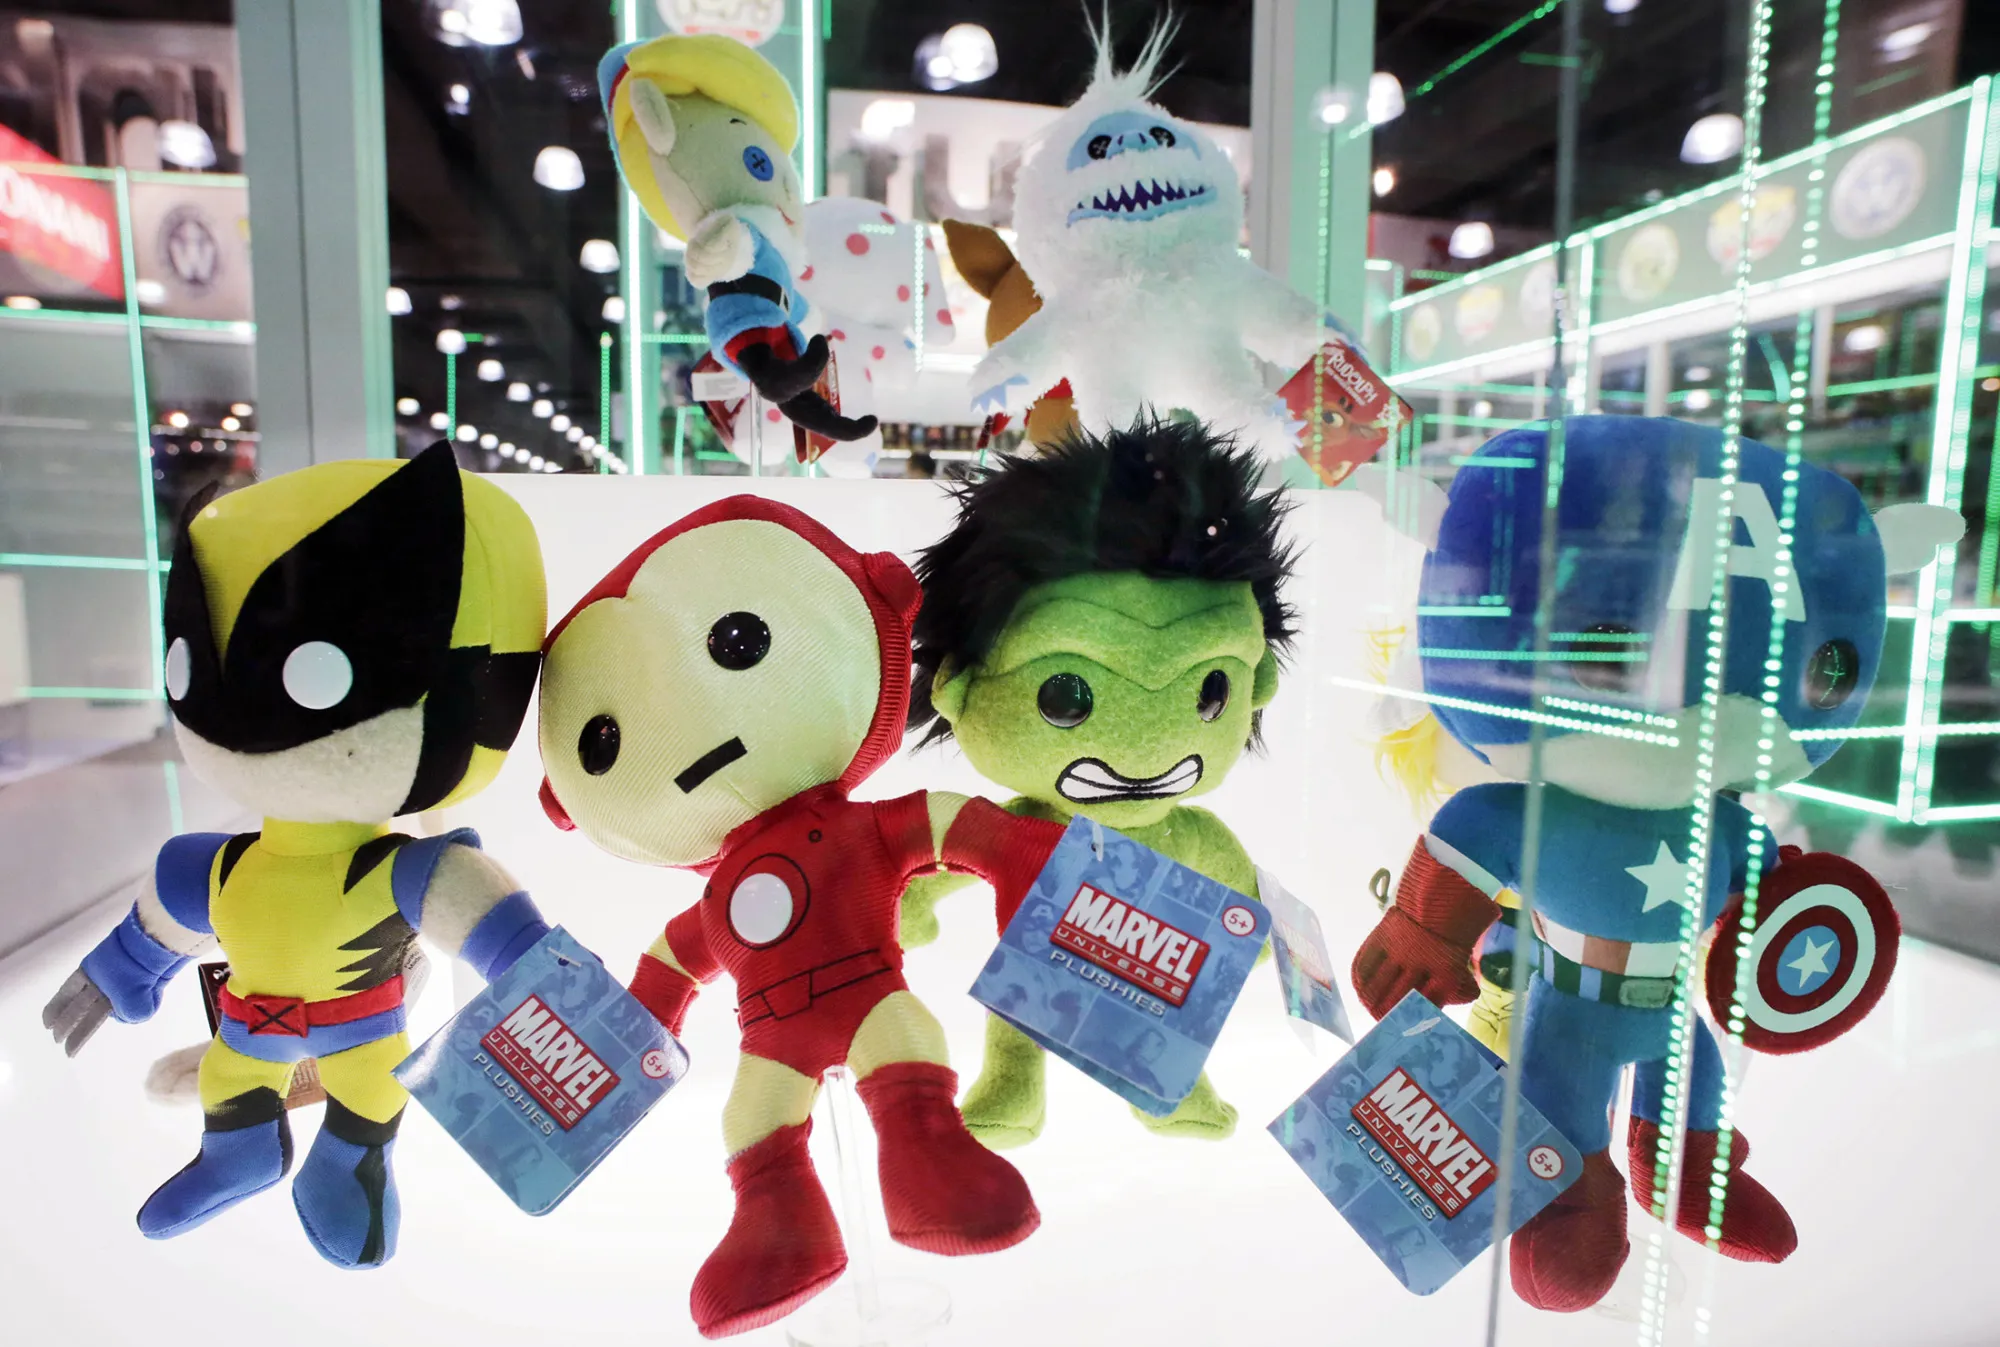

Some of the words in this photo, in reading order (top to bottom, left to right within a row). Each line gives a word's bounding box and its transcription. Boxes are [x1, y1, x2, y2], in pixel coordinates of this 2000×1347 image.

[1327, 352, 1378, 404] RUDOLPH
[1666, 478, 1806, 622] A
[1056, 926, 1185, 998] UNIVERSE
[1064, 885, 1199, 983] MARVEL
[1228, 912, 1249, 930] 5+
[1050, 950, 1167, 1017] PLUSHIES
[473, 1052, 555, 1135] PLUSHIES
[489, 1031, 579, 1122] UNIVERSE
[501, 997, 611, 1110] MARVEL
[647, 1055, 662, 1072] 5+
[1346, 1123, 1437, 1220] PLUSHIES
[1359, 1102, 1459, 1210] UNIVERSE
[1370, 1070, 1491, 1200] MARVEL
[1533, 1152, 1554, 1173] 5+
